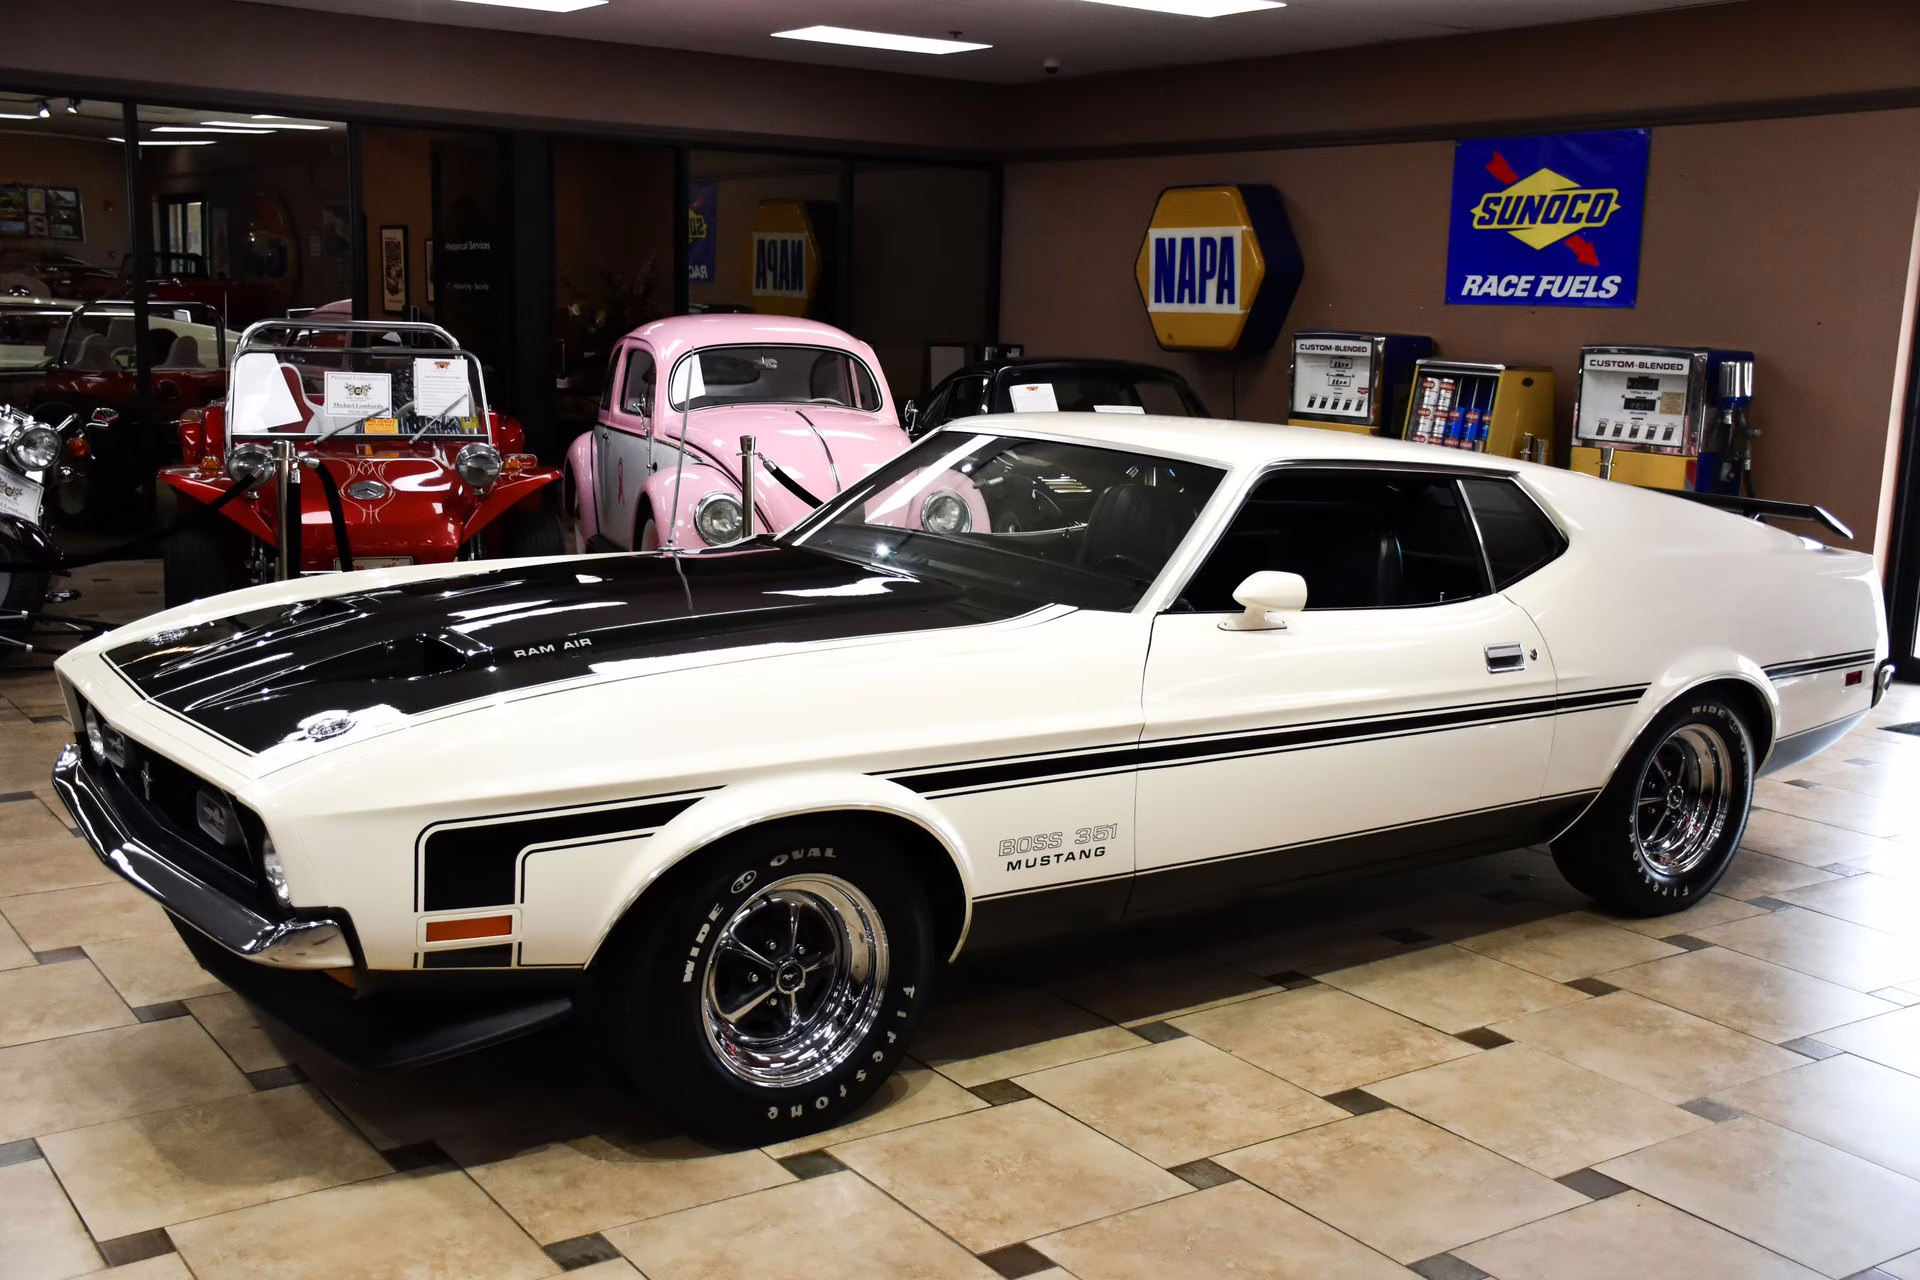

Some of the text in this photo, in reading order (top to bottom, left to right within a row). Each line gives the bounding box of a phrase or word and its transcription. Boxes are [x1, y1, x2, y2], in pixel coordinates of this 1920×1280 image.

[1476, 192, 1615, 226] SUNOCO
[1154, 236, 1236, 305] NAPA
[1460, 274, 1622, 299] RACE FUELS
[1299, 343, 1368, 353] CUSTOM-BLENDED
[1589, 359, 1684, 371] CUSTOM-BLENDED
[513, 638, 593, 658] RAM AIR
[1691, 705, 1726, 719] WIDE
[998, 822, 1118, 857] BOSS 351
[1006, 846, 1106, 872] MUSTANG
[682, 847, 837, 983] WIDE 60 OVAL
